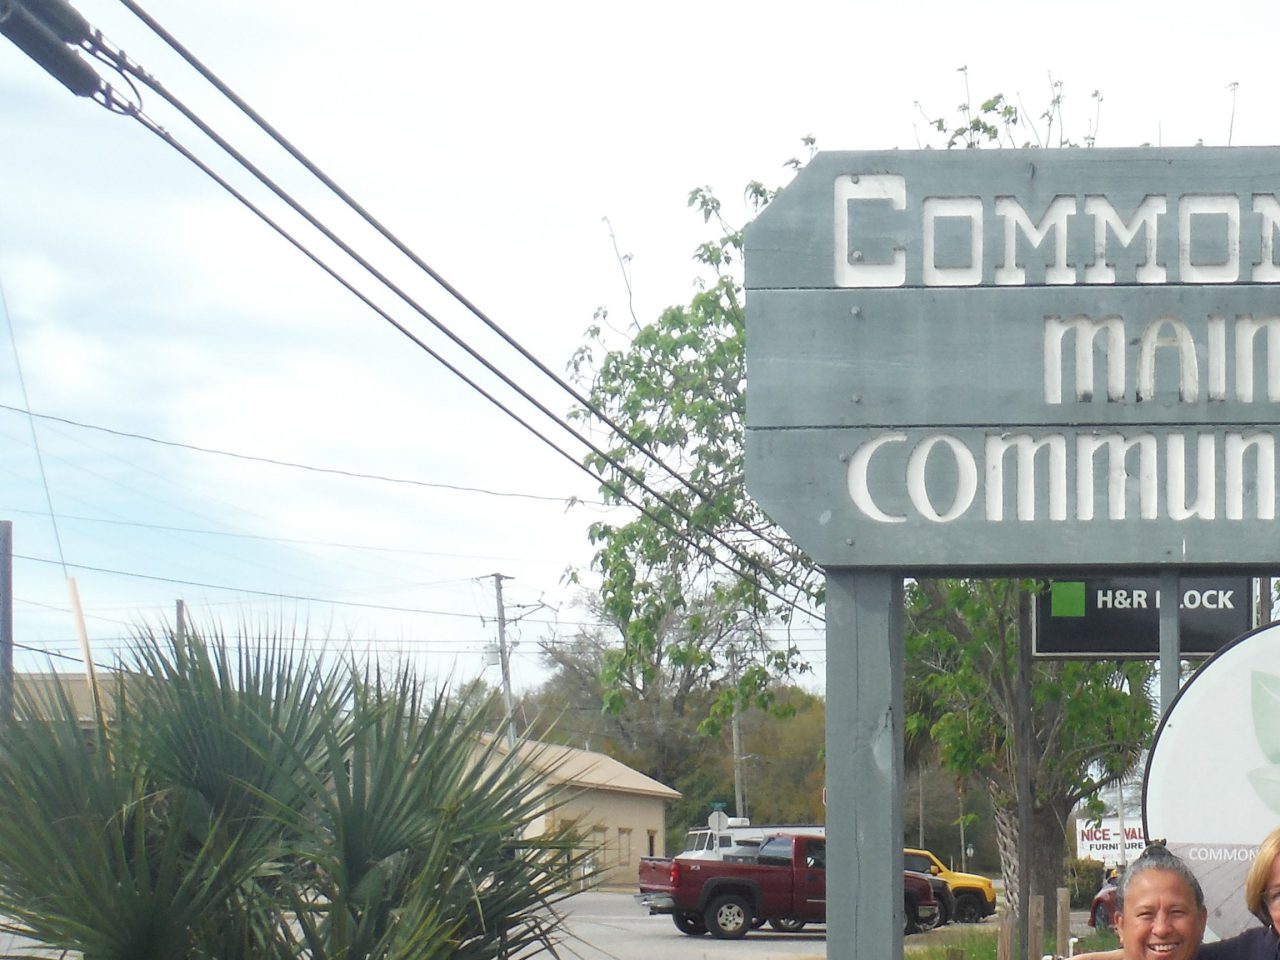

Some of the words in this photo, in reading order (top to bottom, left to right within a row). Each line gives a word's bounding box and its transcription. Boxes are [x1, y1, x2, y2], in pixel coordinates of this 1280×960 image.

[1097, 590, 1147, 609] H&R
[1156, 590, 1235, 609] OCK
[1089, 842, 1144, 851] FURNIURE
[1189, 847, 1259, 861] COMMON
